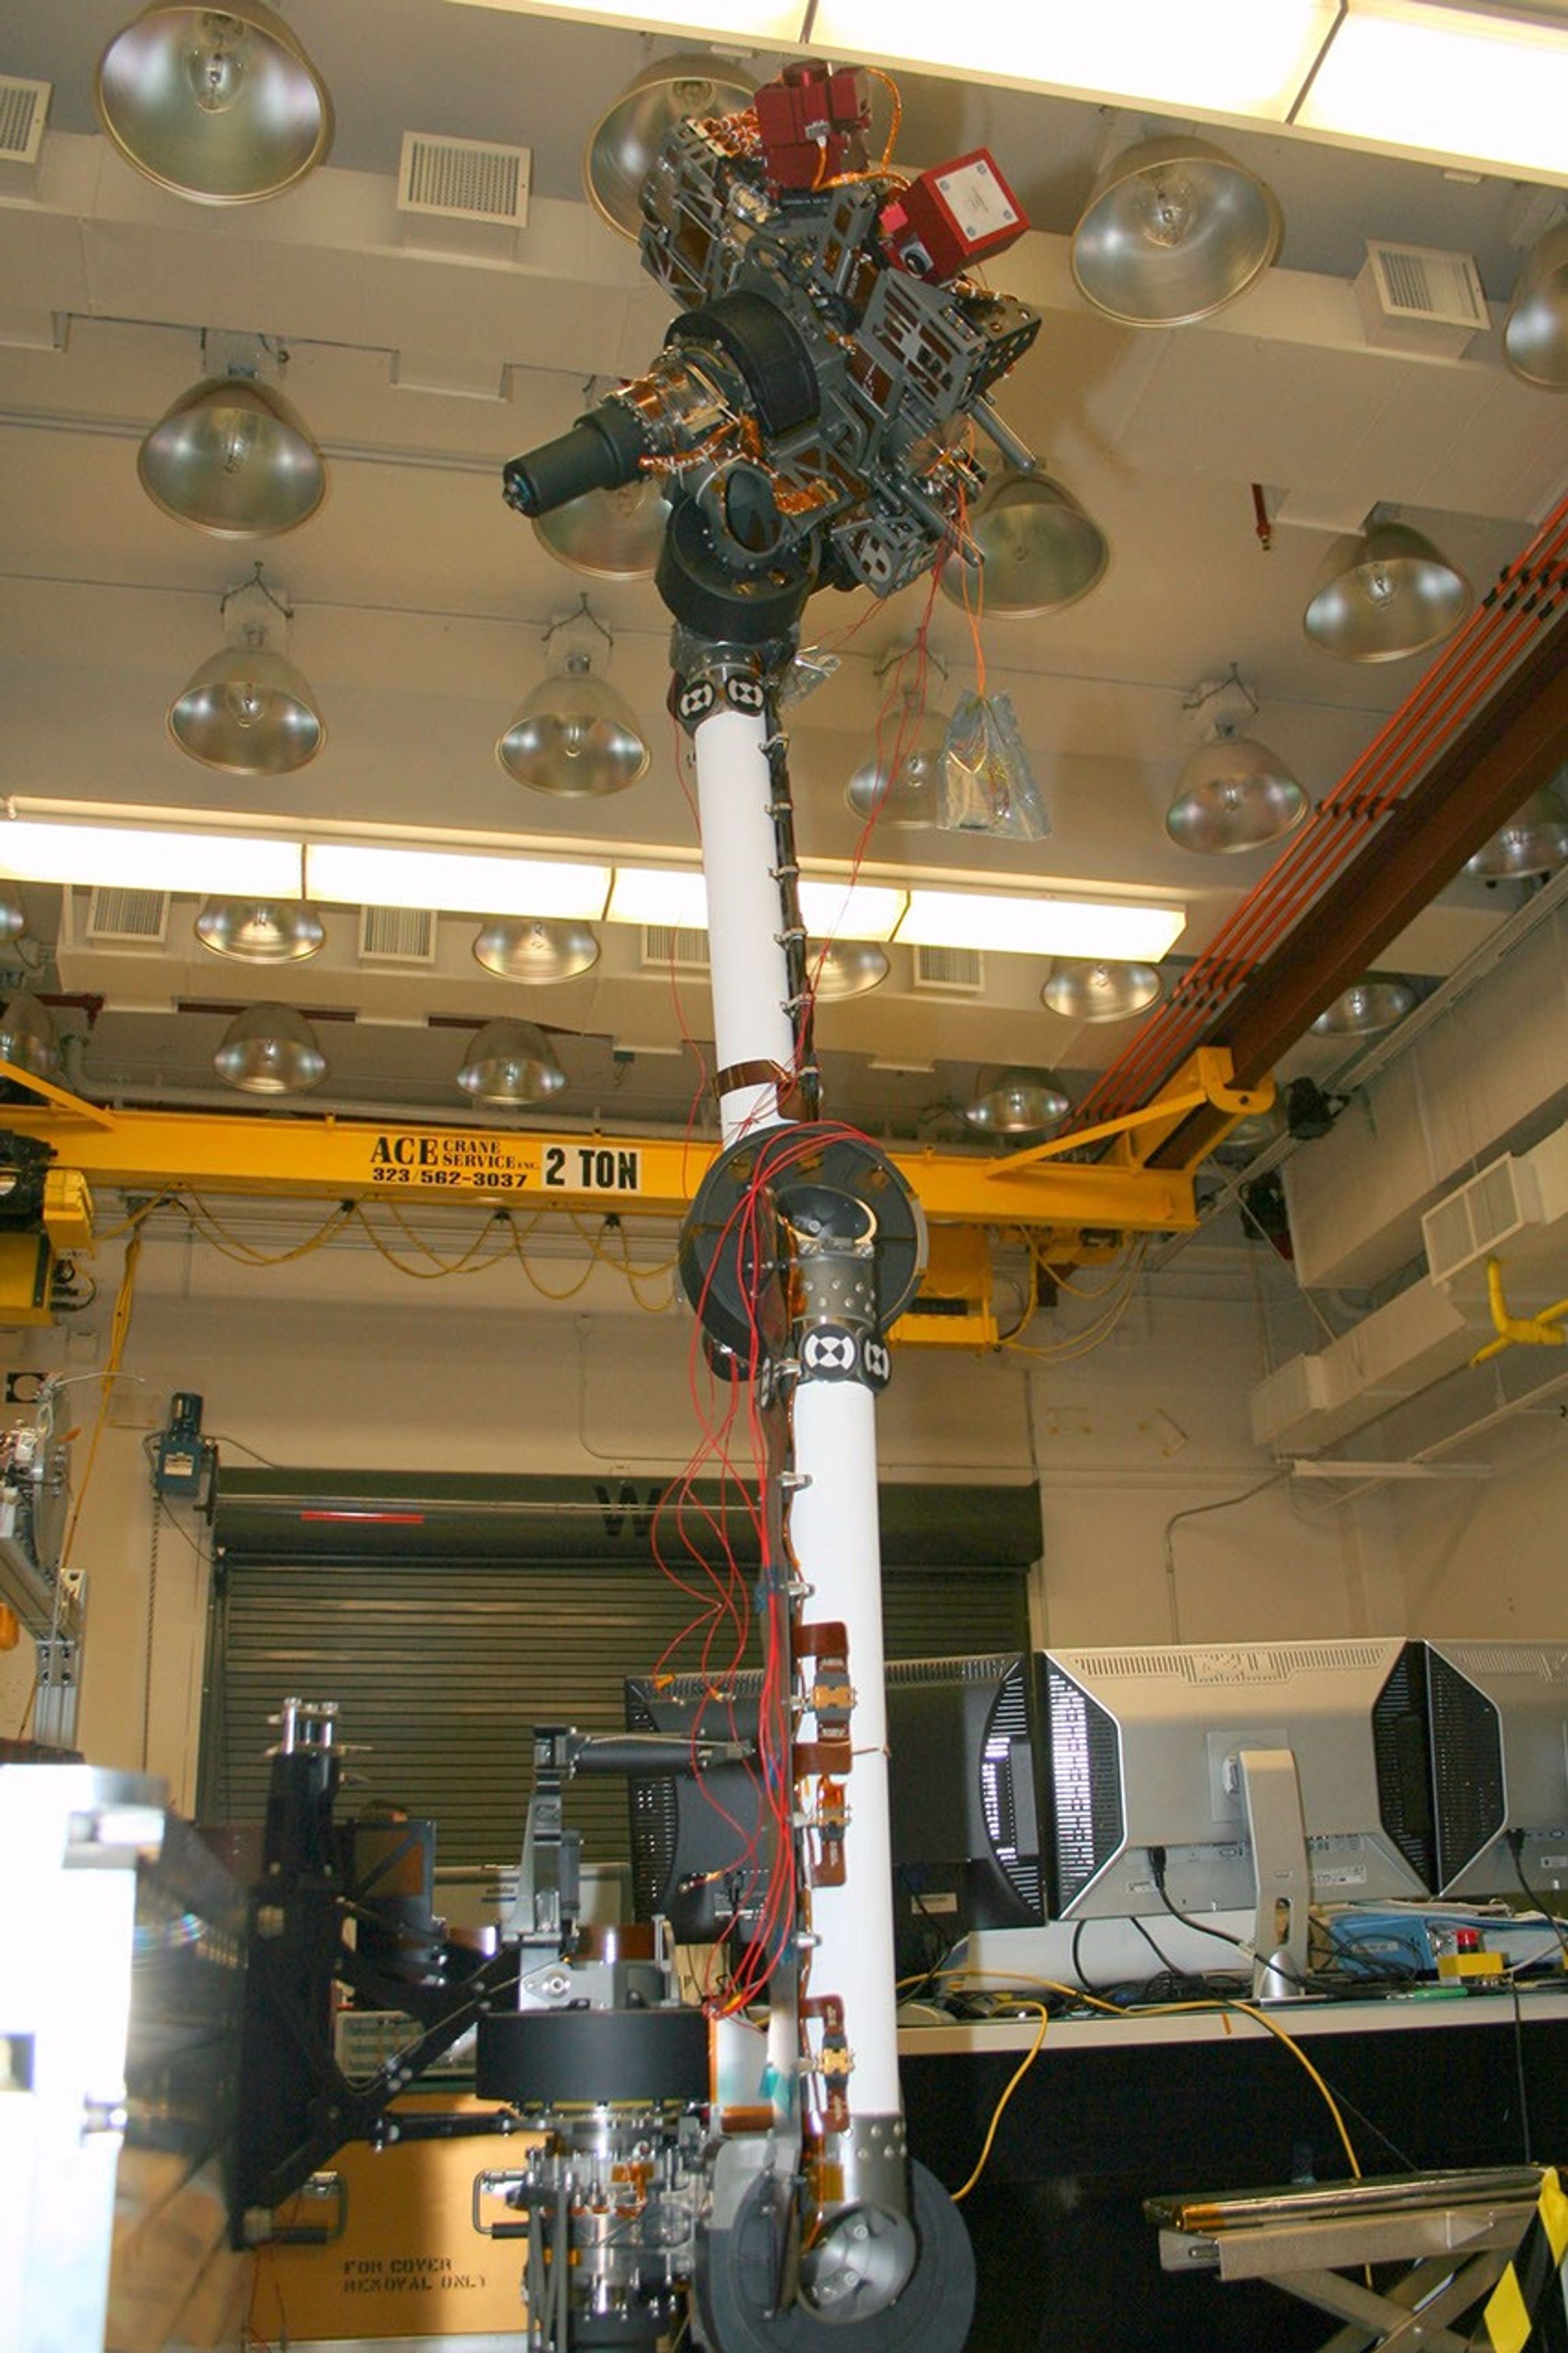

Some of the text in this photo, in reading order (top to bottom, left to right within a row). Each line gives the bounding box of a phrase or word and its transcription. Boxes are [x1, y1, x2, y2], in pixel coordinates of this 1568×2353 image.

[370, 1136, 438, 1166] ACE
[443, 1139, 500, 1153] CRANE
[443, 1155, 515, 1169] SERVICE
[546, 1148, 637, 1189] 2 TON
[372, 1167, 528, 1188] 323/562-3037
[344, 2257, 451, 2275] FOR COVER
[344, 2277, 433, 2293] REMOVAL
